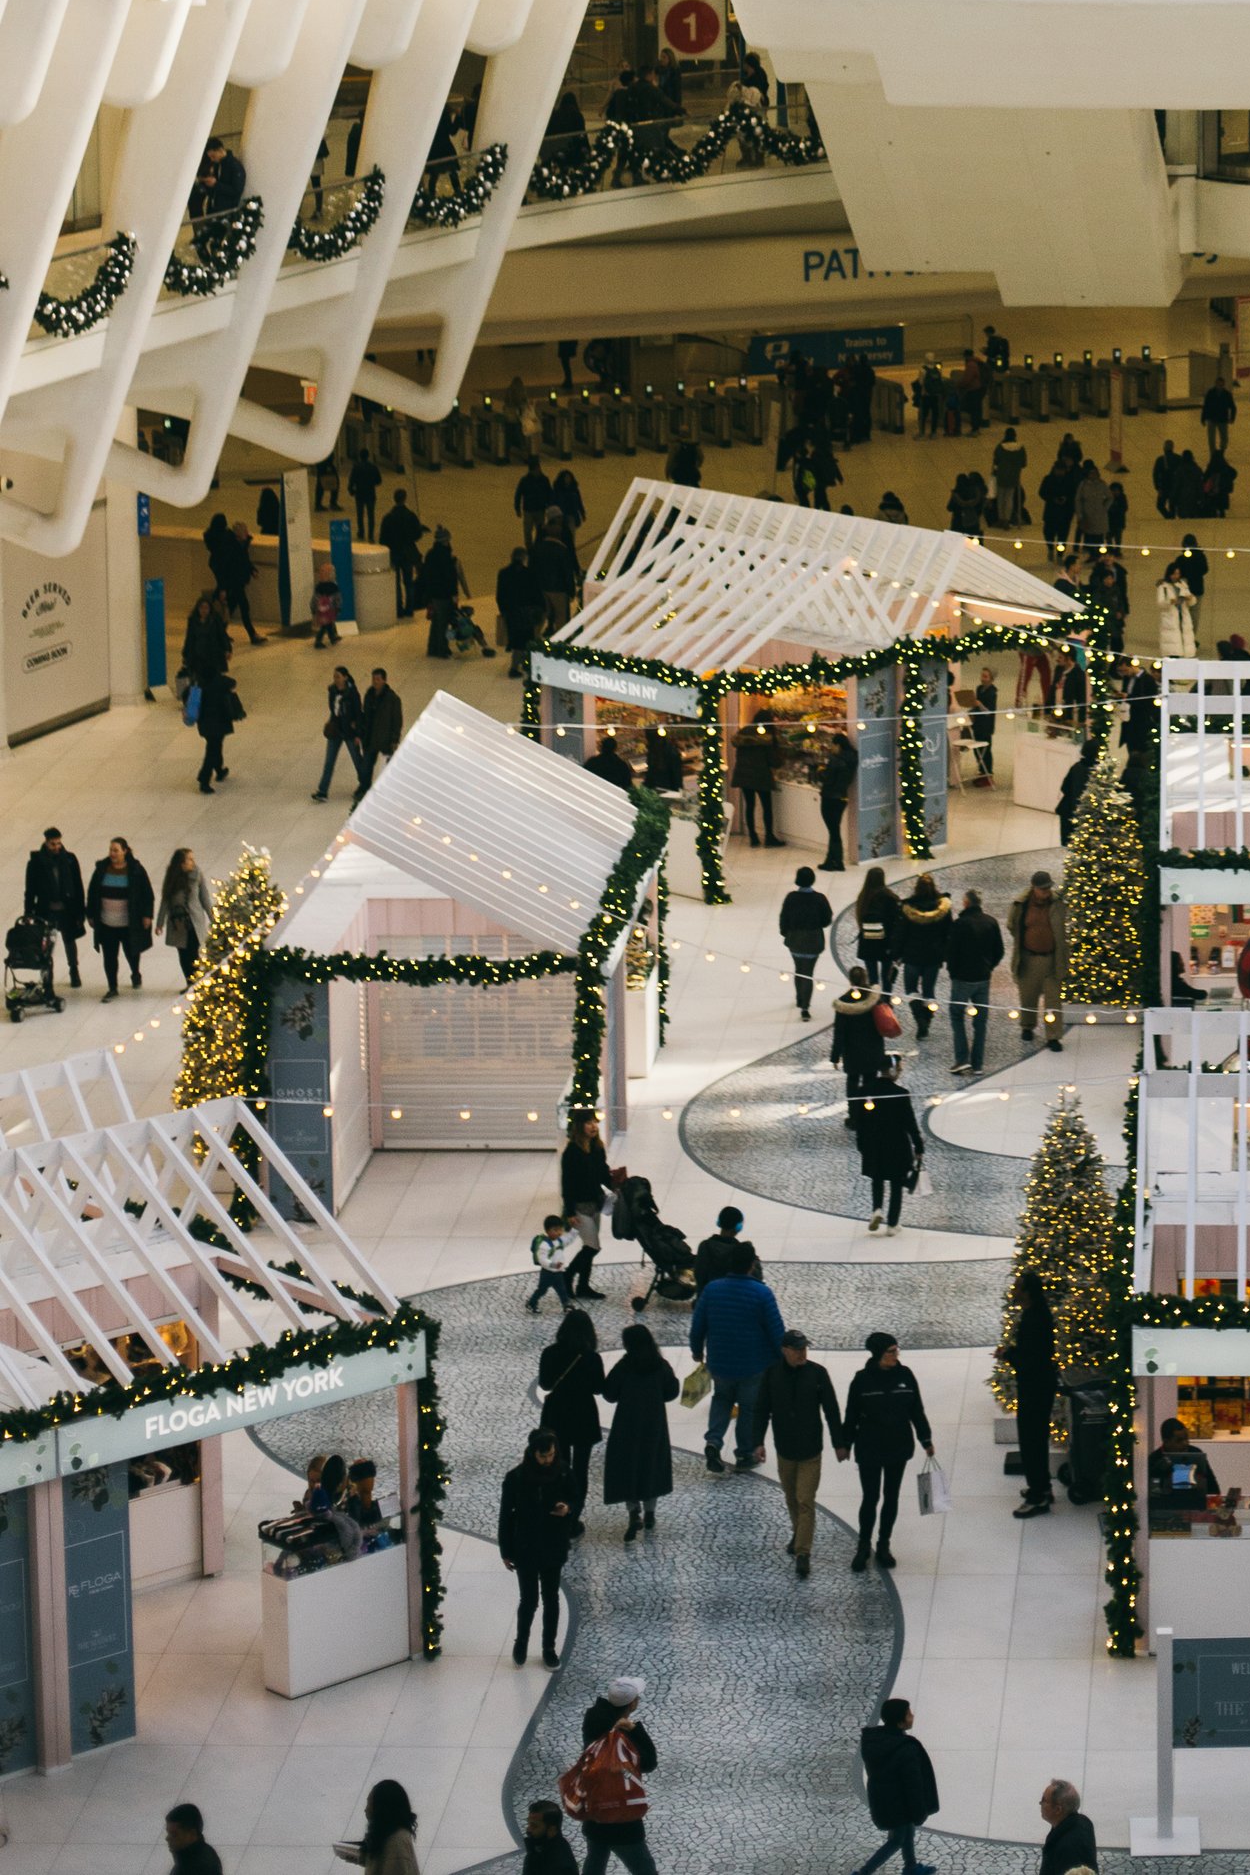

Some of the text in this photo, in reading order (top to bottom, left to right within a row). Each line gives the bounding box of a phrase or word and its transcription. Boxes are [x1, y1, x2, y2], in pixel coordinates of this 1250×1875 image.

[682, 11, 698, 42] 1
[803, 247, 892, 283] PAT
[844, 335, 887, 349] Trains to
[861, 349, 894, 363] ersey
[21, 581, 72, 619] BEER SERVED
[26, 646, 68, 669] COMING SOON
[568, 668, 659, 701] CHRISTMAS IN NY
[276, 1088, 322, 1098] GHOST
[146, 1366, 344, 1440] FLOGA NEW YORK
[80, 1571, 122, 1590] FLOGA
[1215, 1701, 1245, 1716] THE
